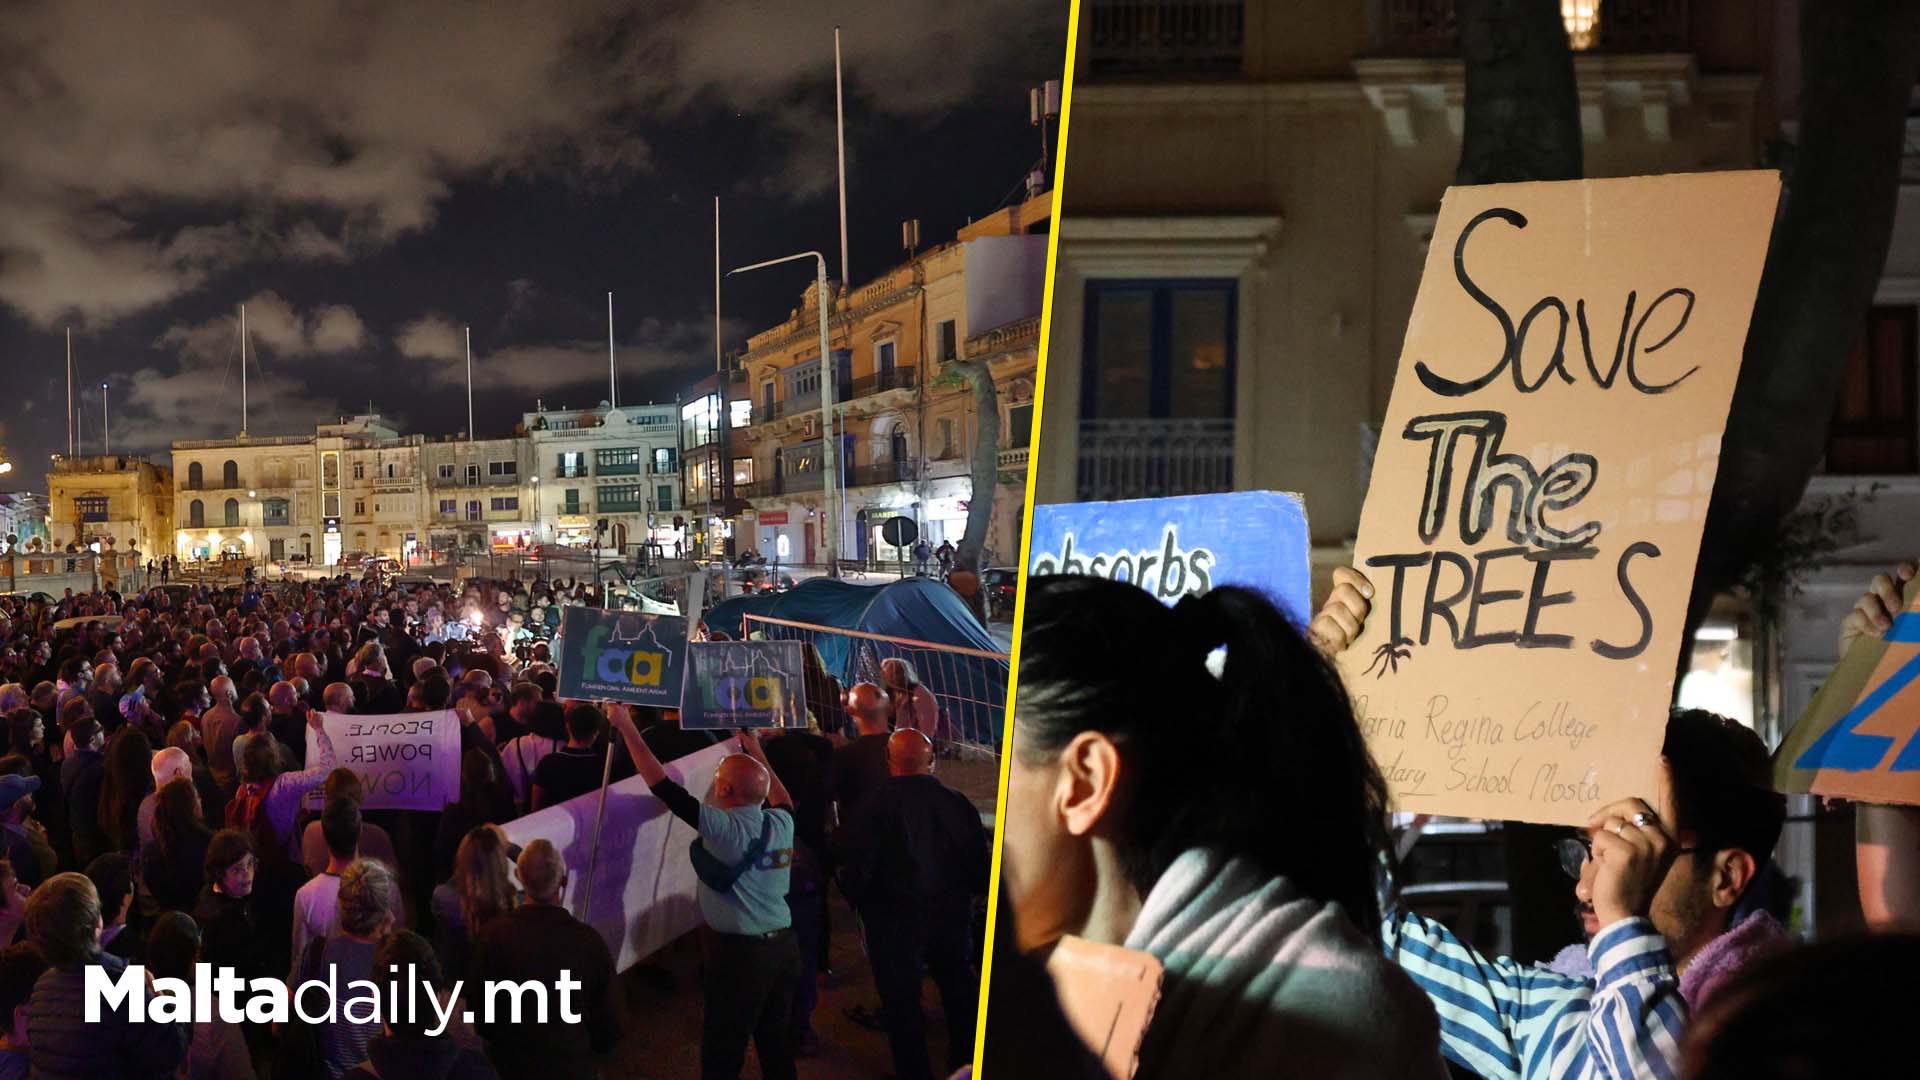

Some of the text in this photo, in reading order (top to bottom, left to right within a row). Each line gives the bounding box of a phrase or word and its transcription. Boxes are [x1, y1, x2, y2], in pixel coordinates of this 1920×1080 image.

[1414, 208, 1700, 396] Save
[1403, 410, 1601, 549] The
[1366, 541, 1661, 660] TREES
[1425, 694, 1504, 760] Regina
[1514, 700, 1598, 750] College
[1445, 756, 1523, 794] School
[1530, 763, 1601, 802] Mosta
